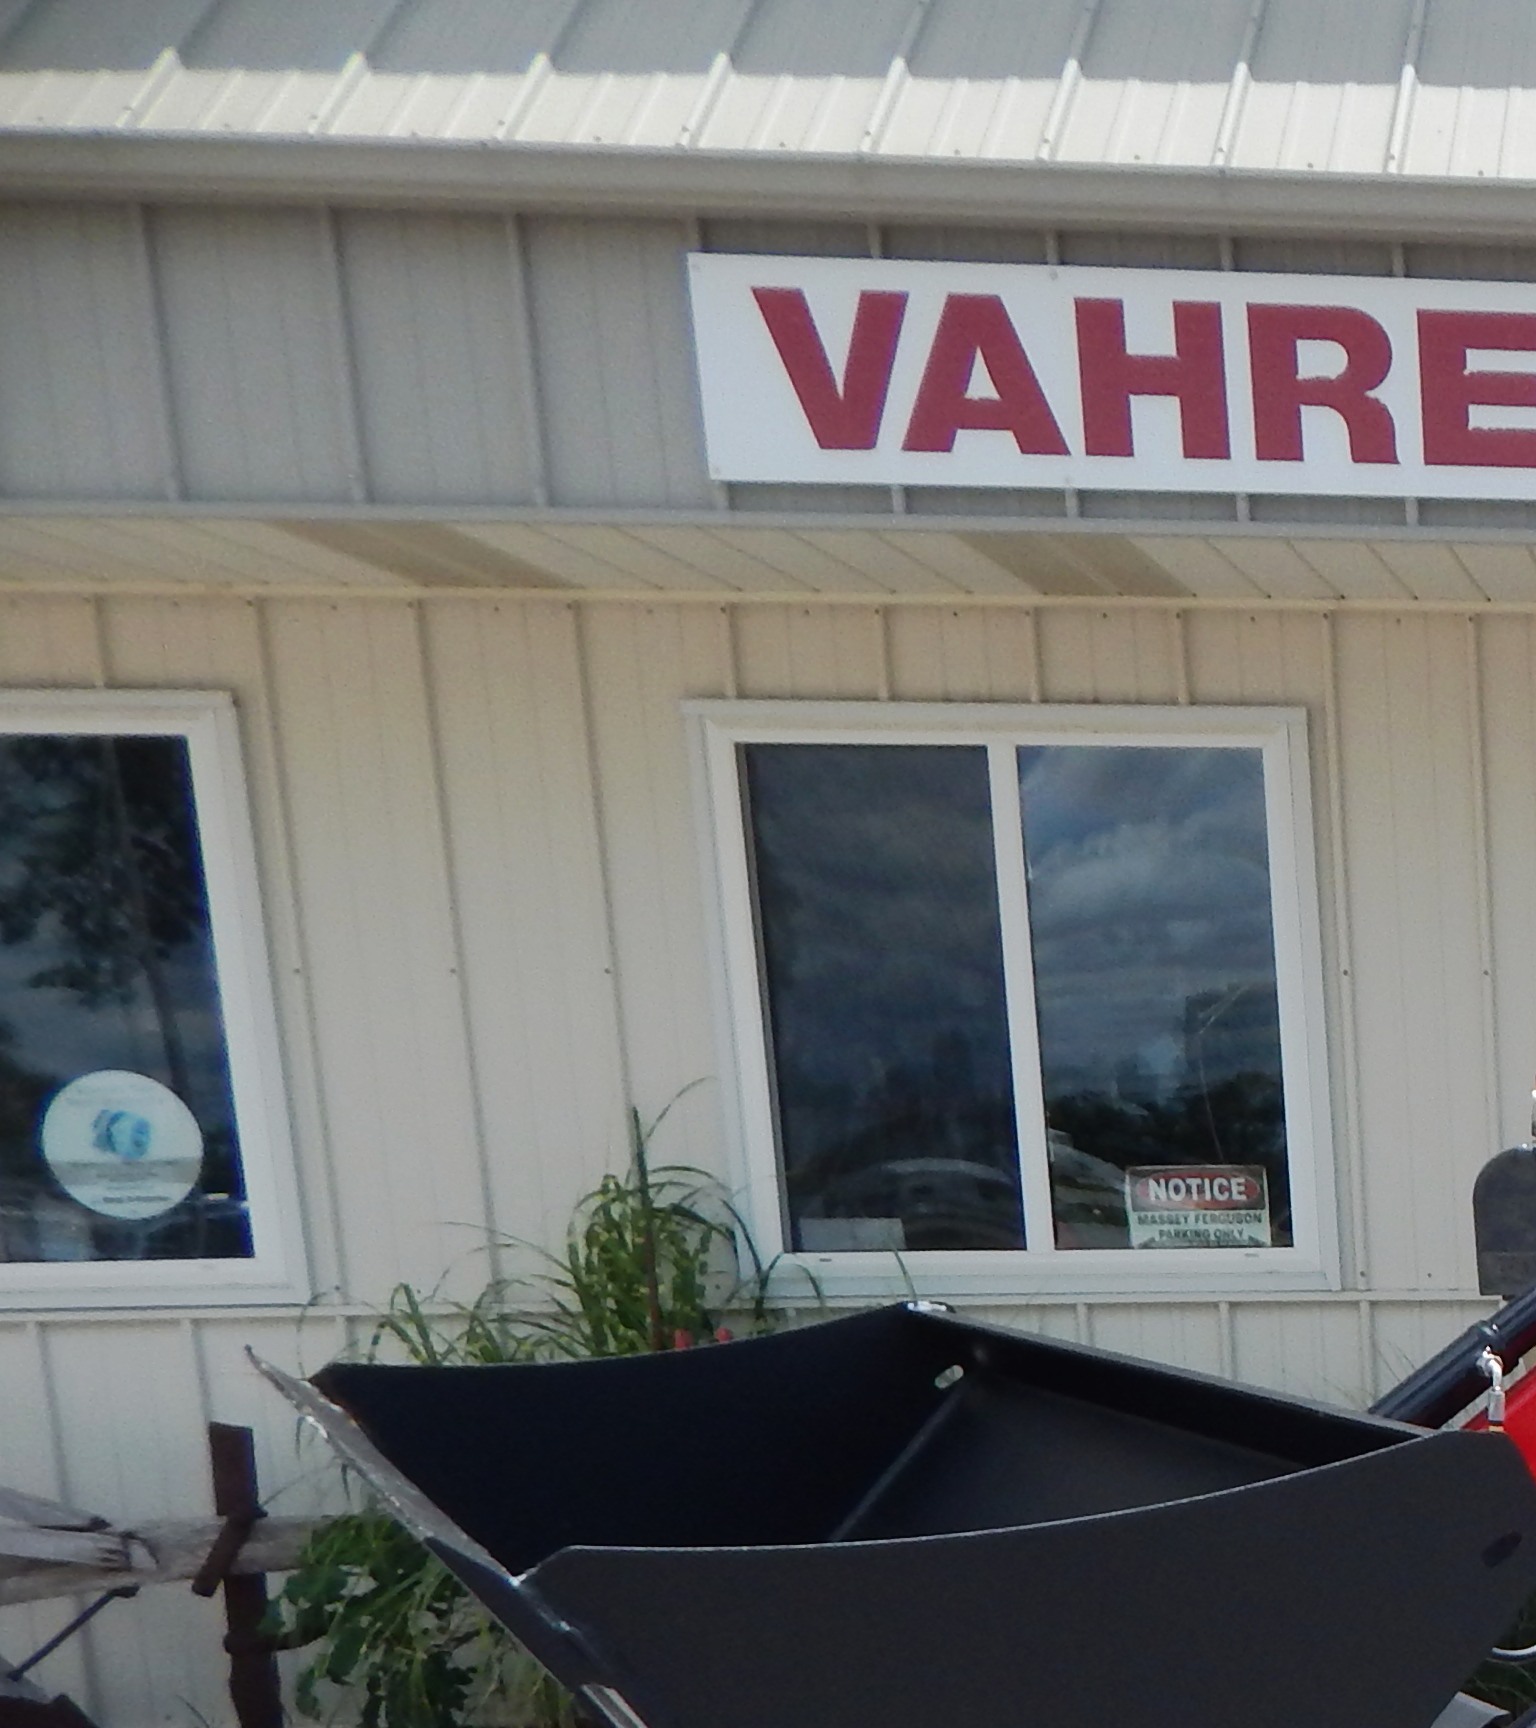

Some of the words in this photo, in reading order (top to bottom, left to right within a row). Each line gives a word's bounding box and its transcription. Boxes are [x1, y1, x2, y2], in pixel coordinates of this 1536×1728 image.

[1147, 1177, 1248, 1202] NOTICE
[1159, 1228, 1211, 1240] PARKING
[1213, 1228, 1245, 1240] ONLY
